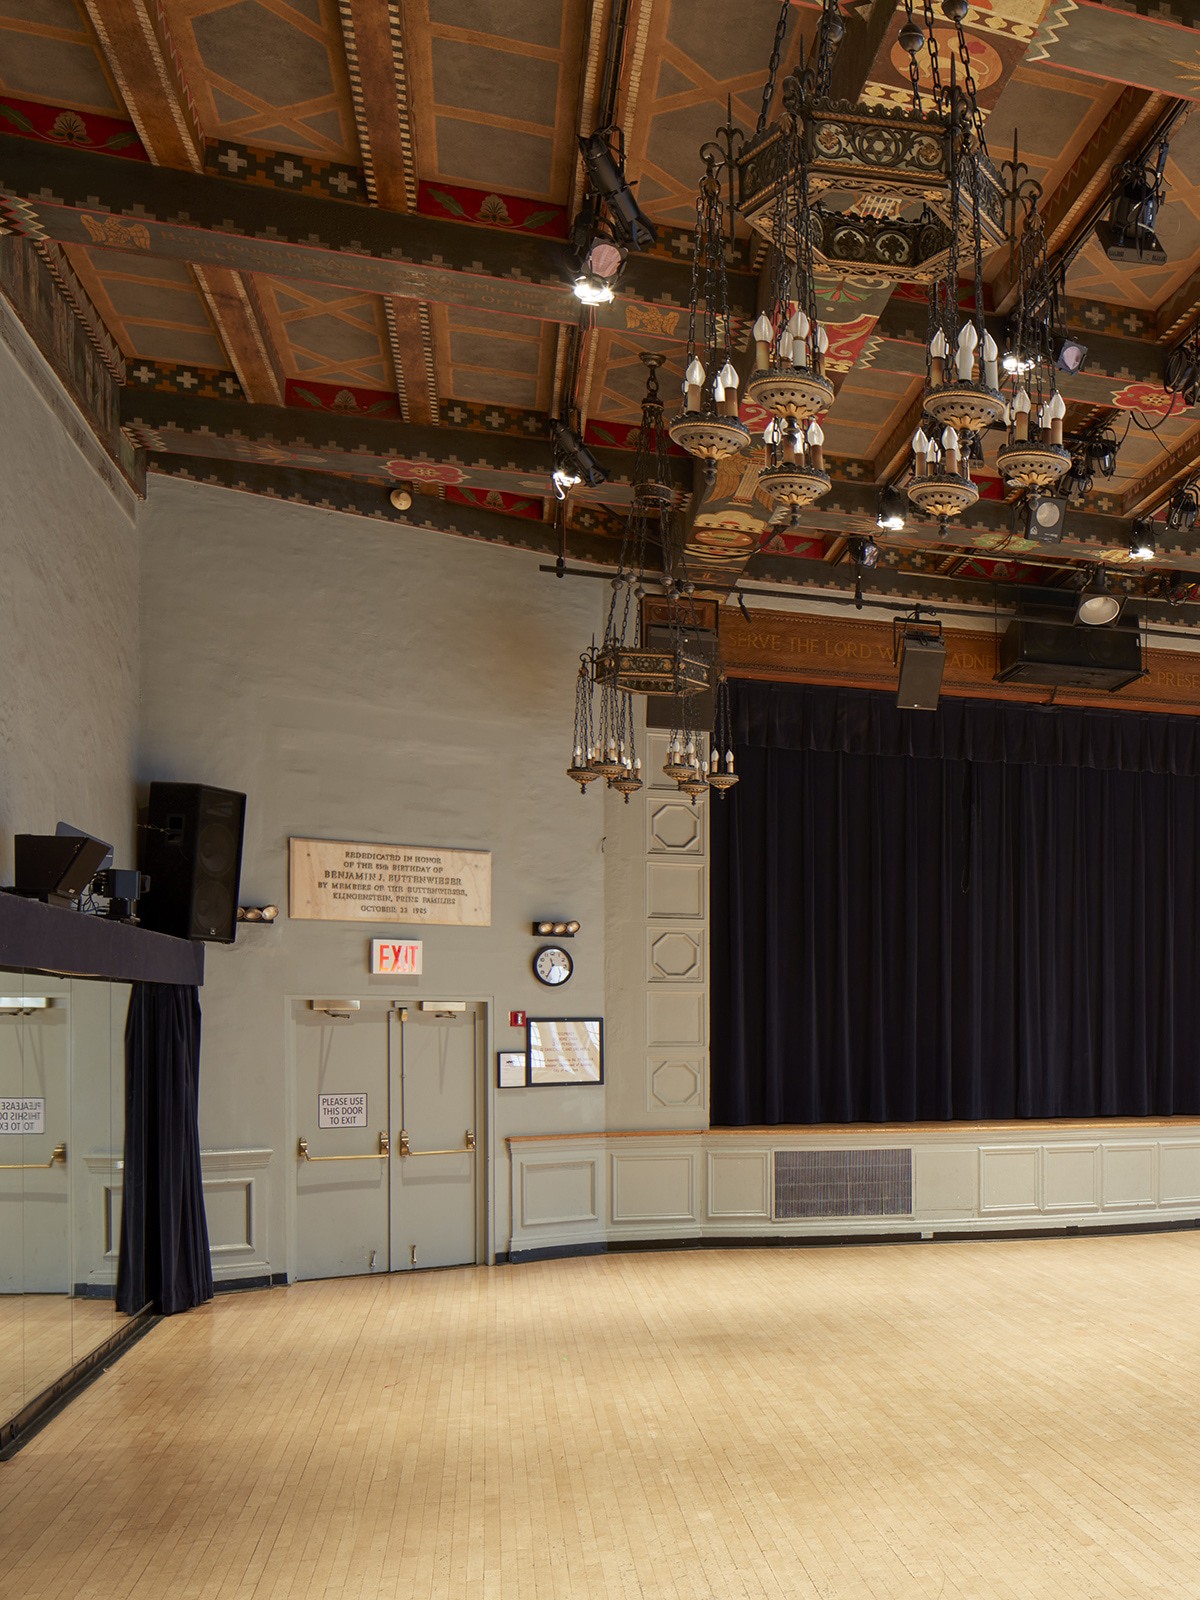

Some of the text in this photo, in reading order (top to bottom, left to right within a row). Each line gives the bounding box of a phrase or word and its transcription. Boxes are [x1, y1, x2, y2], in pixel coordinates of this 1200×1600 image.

[728, 632, 781, 651] SERVE
[789, 636, 819, 654] THE
[824, 639, 872, 659] LORD
[345, 851, 401, 862] REDEDICATED
[415, 856, 442, 864] HONOR
[356, 862, 373, 870] THE
[392, 864, 431, 873] BIRTHDAY
[324, 870, 462, 886] BENJAMIN J. BUTTENWIESER
[318, 881, 328, 889] BY
[331, 882, 371, 891] MEMBERS
[374, 884, 385, 892] OF
[387, 885, 404, 893] THE
[422, 896, 456, 905] FAMILIES
[360, 905, 396, 913] OCTOBER
[379, 944, 419, 972] EXIT
[322, 1097, 364, 1106] PLEASE USE
[323, 1106, 363, 1115] THIS DOOR
[330, 1116, 357, 1125] TO EXIT
